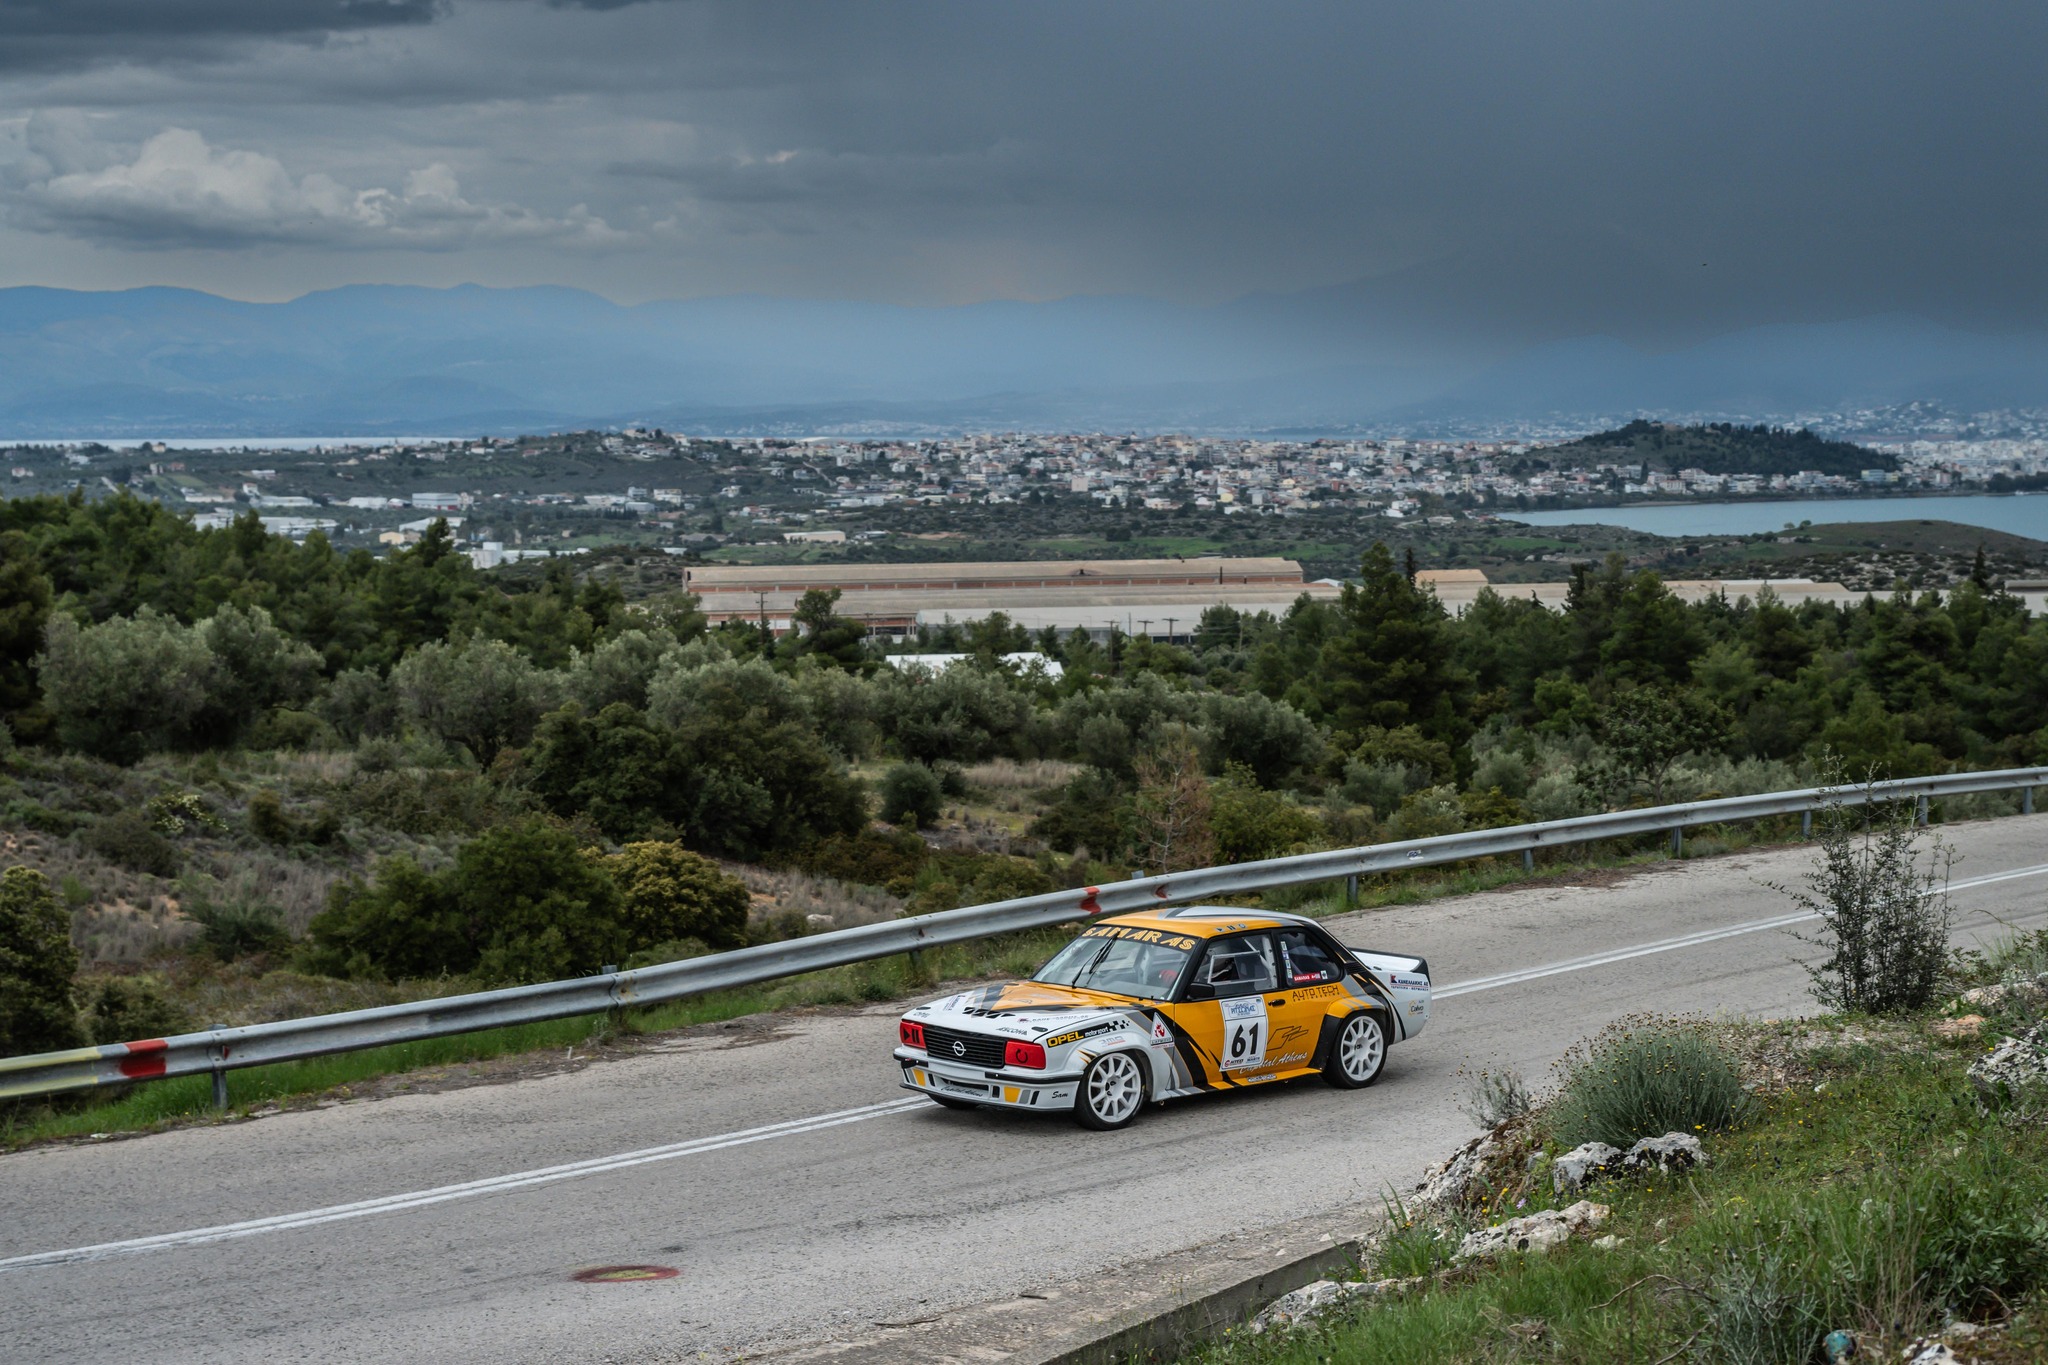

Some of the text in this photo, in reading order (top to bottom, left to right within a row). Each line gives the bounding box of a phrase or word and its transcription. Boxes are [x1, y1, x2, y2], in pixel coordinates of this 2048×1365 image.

[1082, 926, 1196, 950] SAMARAS
[1292, 984, 1339, 999] AUTO TECH
[1047, 1031, 1085, 1047] OPEL
[1084, 1026, 1109, 1038] motorsport
[1231, 1022, 1259, 1058] 61
[1276, 1051, 1308, 1066] Athens
[1051, 1091, 1069, 1099] Sam
